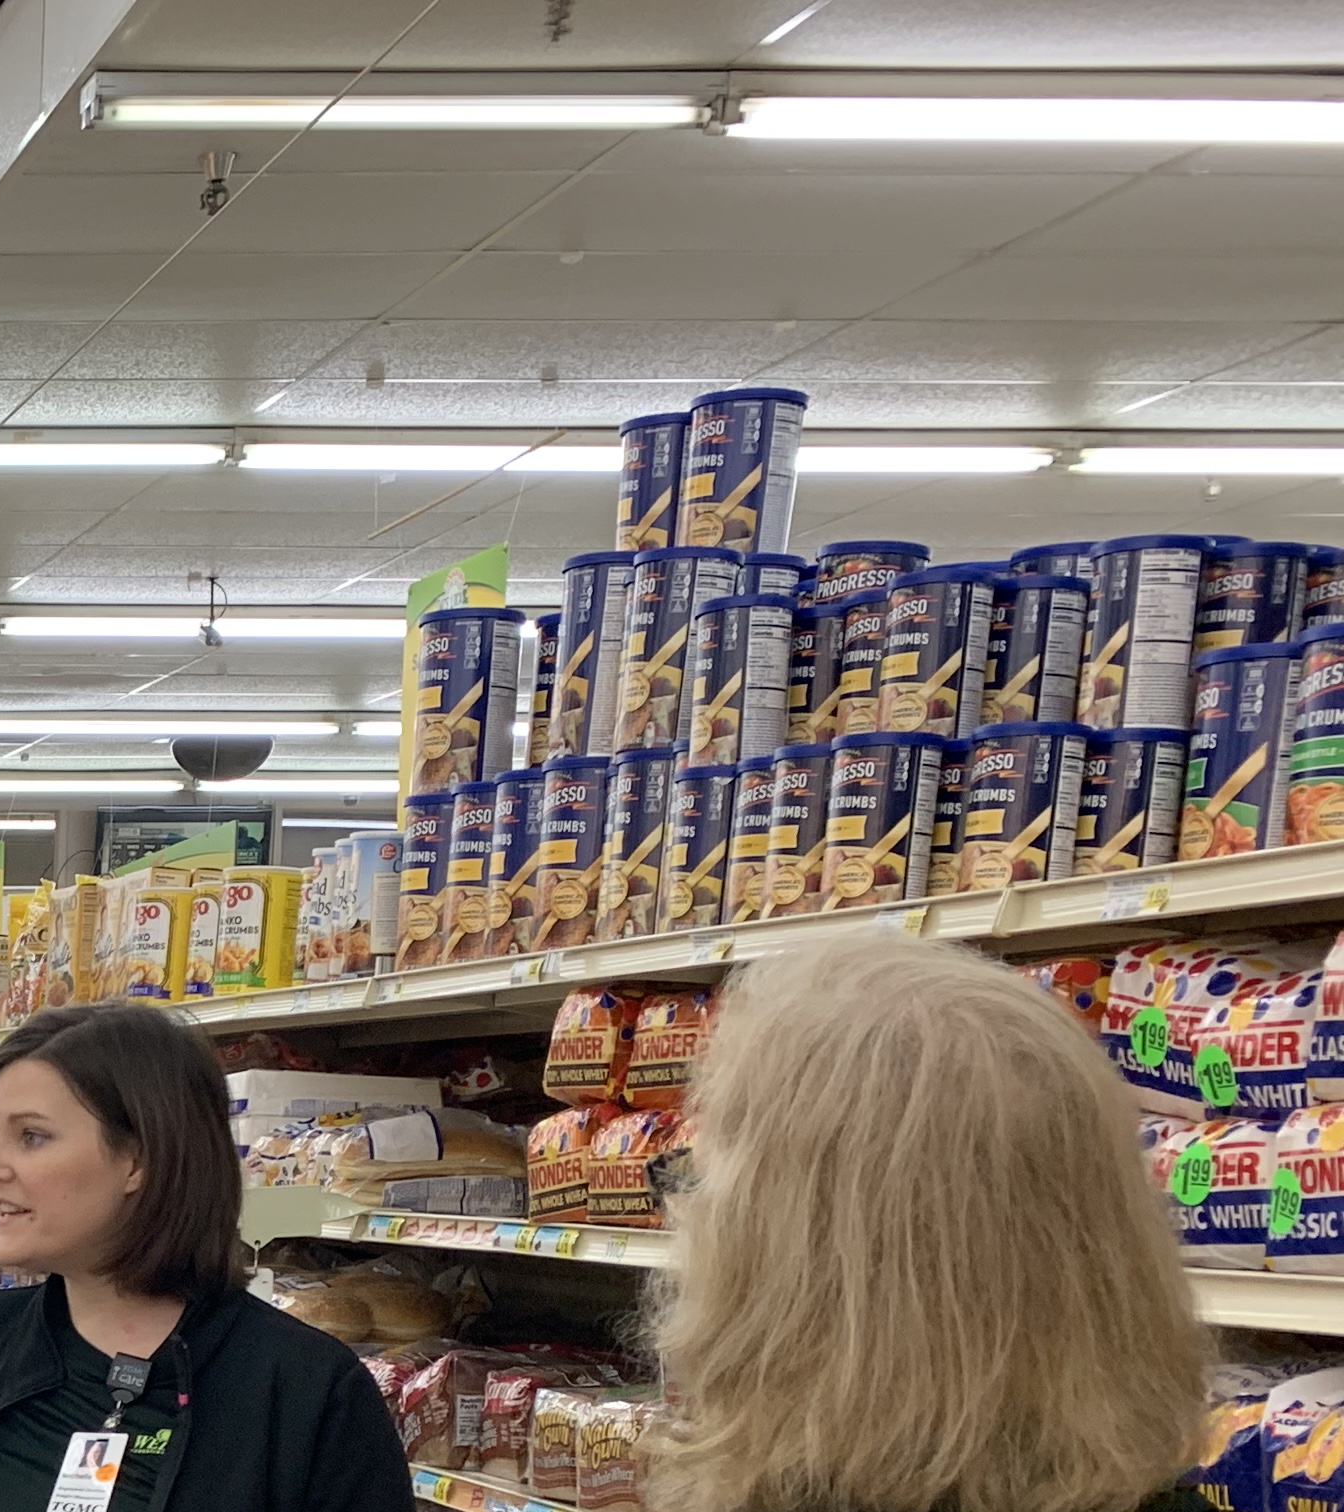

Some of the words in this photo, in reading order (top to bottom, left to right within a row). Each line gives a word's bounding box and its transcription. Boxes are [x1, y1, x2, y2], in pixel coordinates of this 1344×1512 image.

[816, 568, 896, 600] PROGRESSO
[889, 632, 929, 646] CRUMBS
[972, 788, 1016, 803] CRUMBS
[834, 796, 877, 811] CRUMBS
[547, 820, 587, 834] CRUMBS
[454, 840, 492, 853] CRUMBS
[550, 1036, 604, 1062] WONDER
[634, 1032, 698, 1061] WONDER
[529, 1157, 583, 1189] WONDER
[588, 1163, 645, 1190] WONDER
[118, 1373, 145, 1388] care
